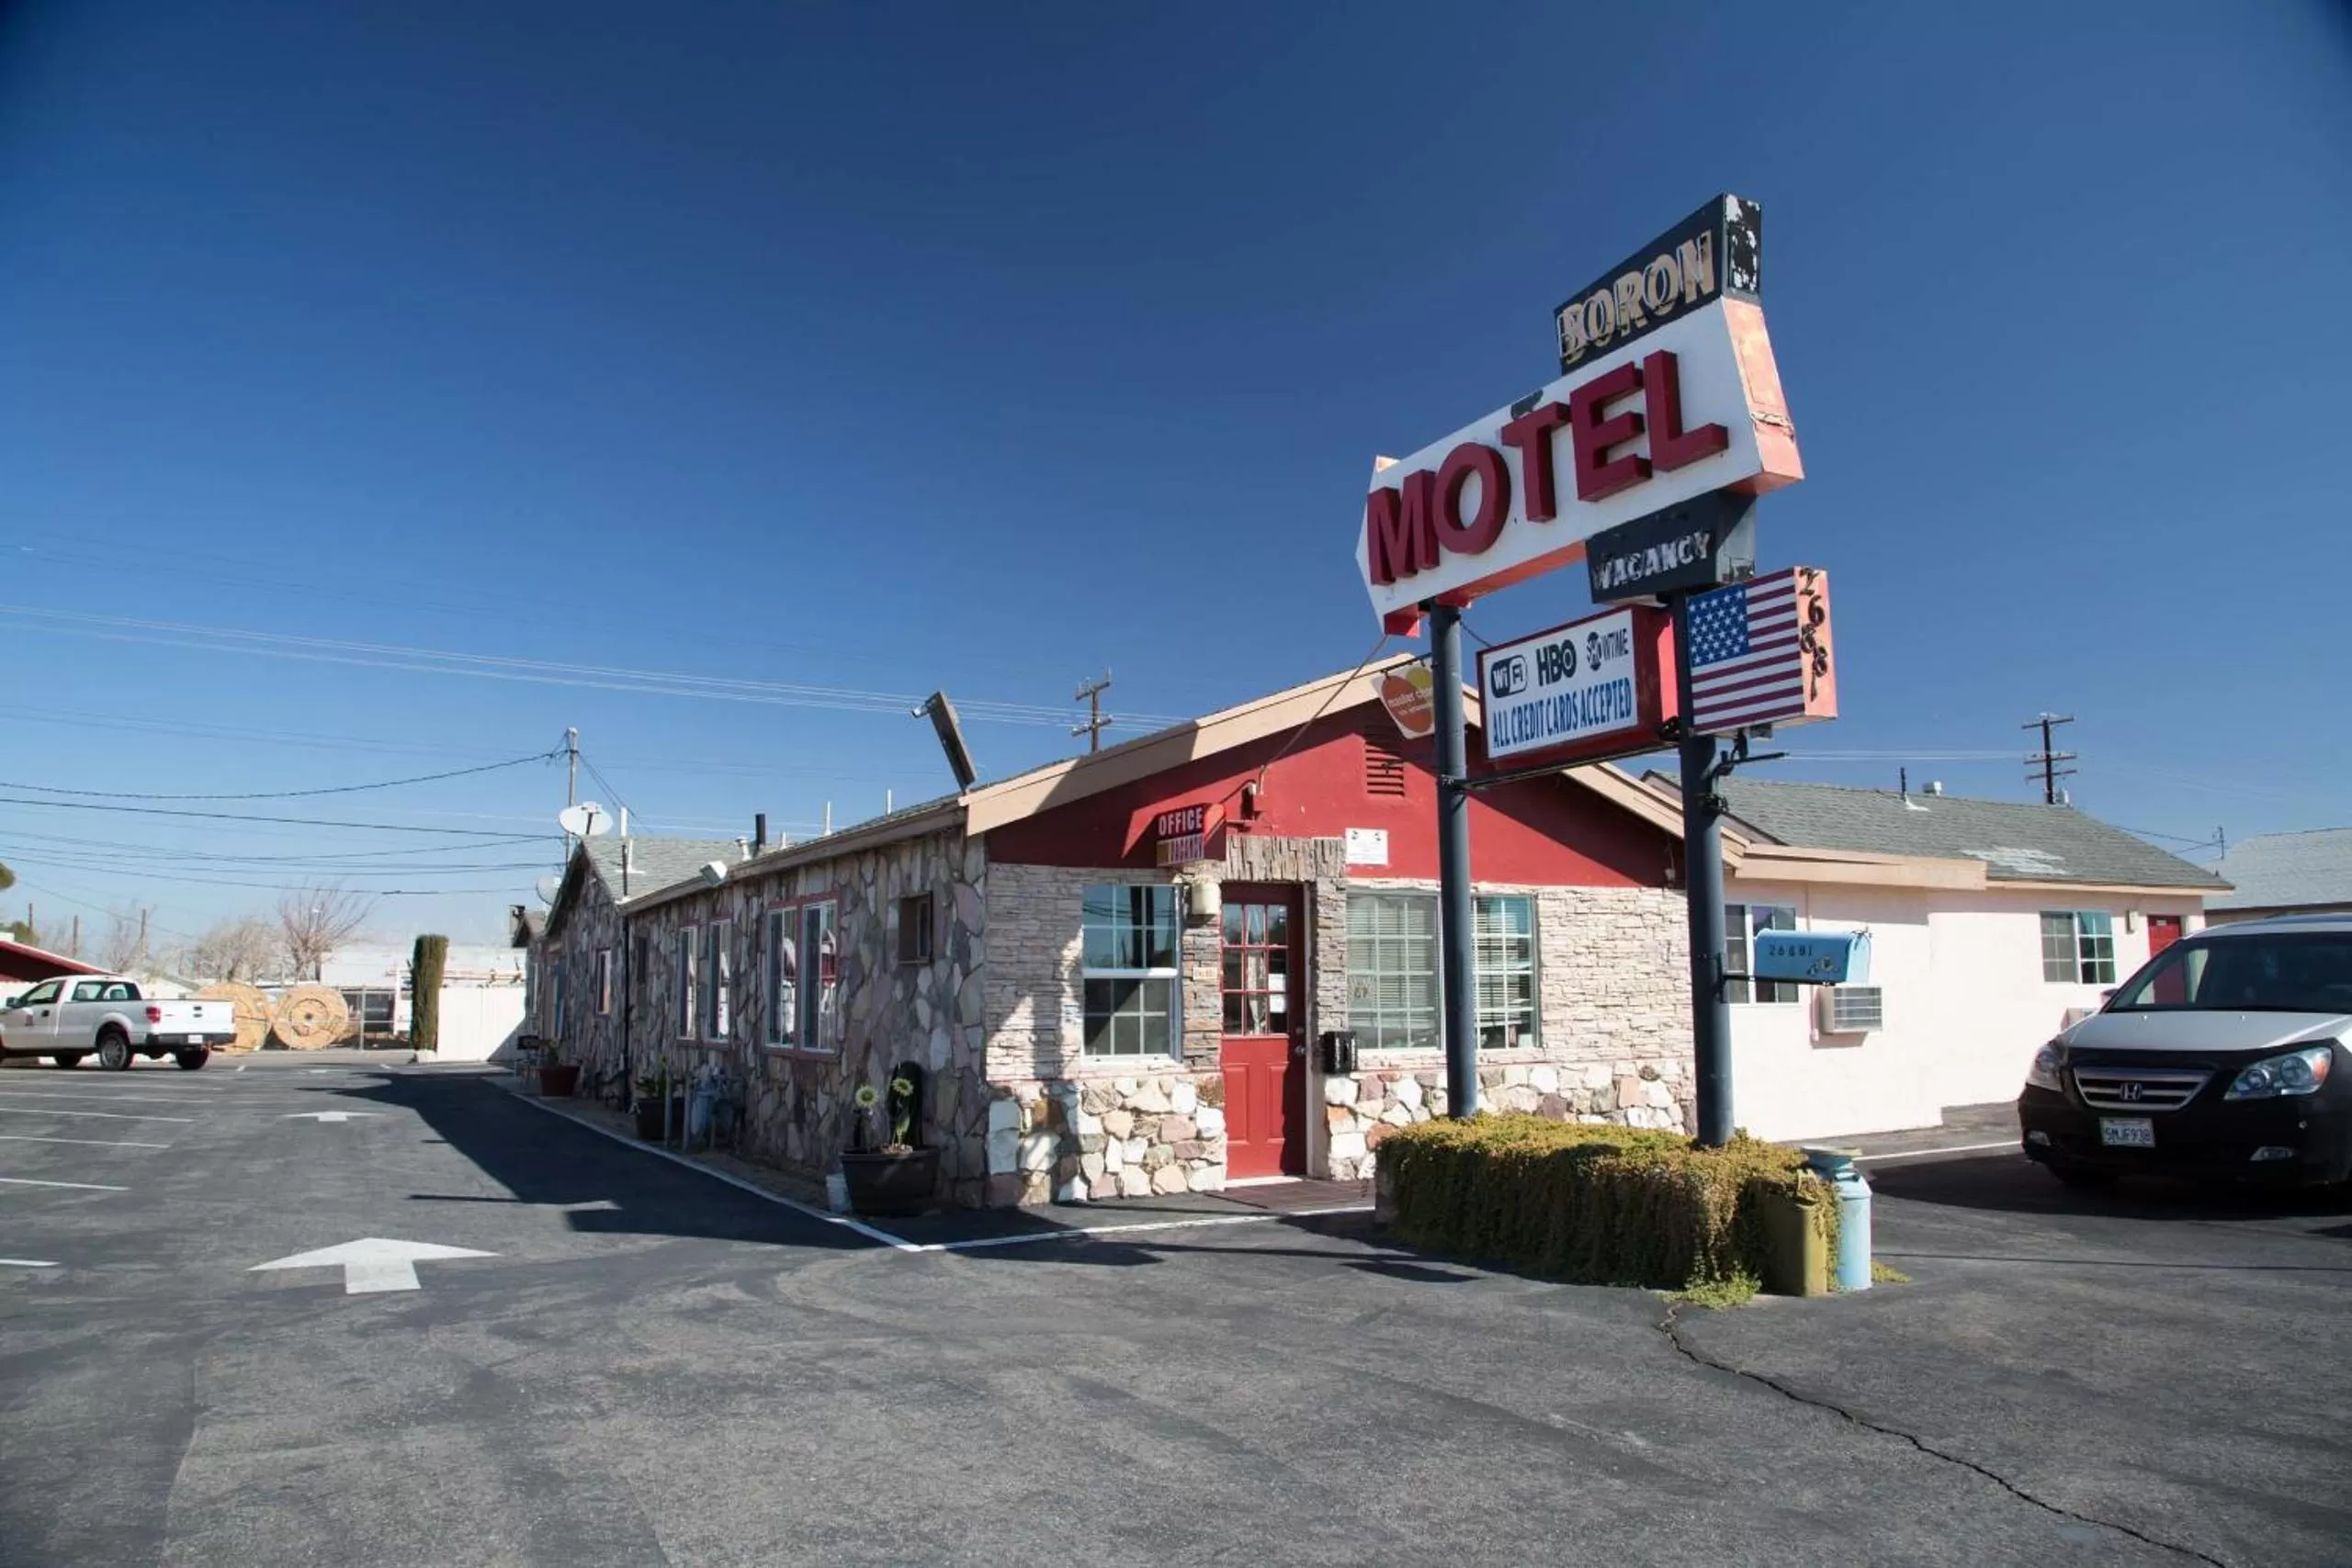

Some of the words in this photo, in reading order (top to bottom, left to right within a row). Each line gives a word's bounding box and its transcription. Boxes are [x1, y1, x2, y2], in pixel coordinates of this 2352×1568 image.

[1557, 229, 1714, 364] BORON
[1366, 348, 1729, 586] MOTEL
[1592, 531, 1711, 589] VACANCY
[1536, 639, 1577, 687] HBO
[1587, 628, 1629, 671] SHOWTIME
[1493, 710, 1510, 748] ALL
[1511, 699, 1544, 742] CREDIT
[1545, 690, 1578, 736] CARDS
[1580, 677, 1632, 728] ACCEPTED
[1159, 807, 1203, 837] OFFICE
